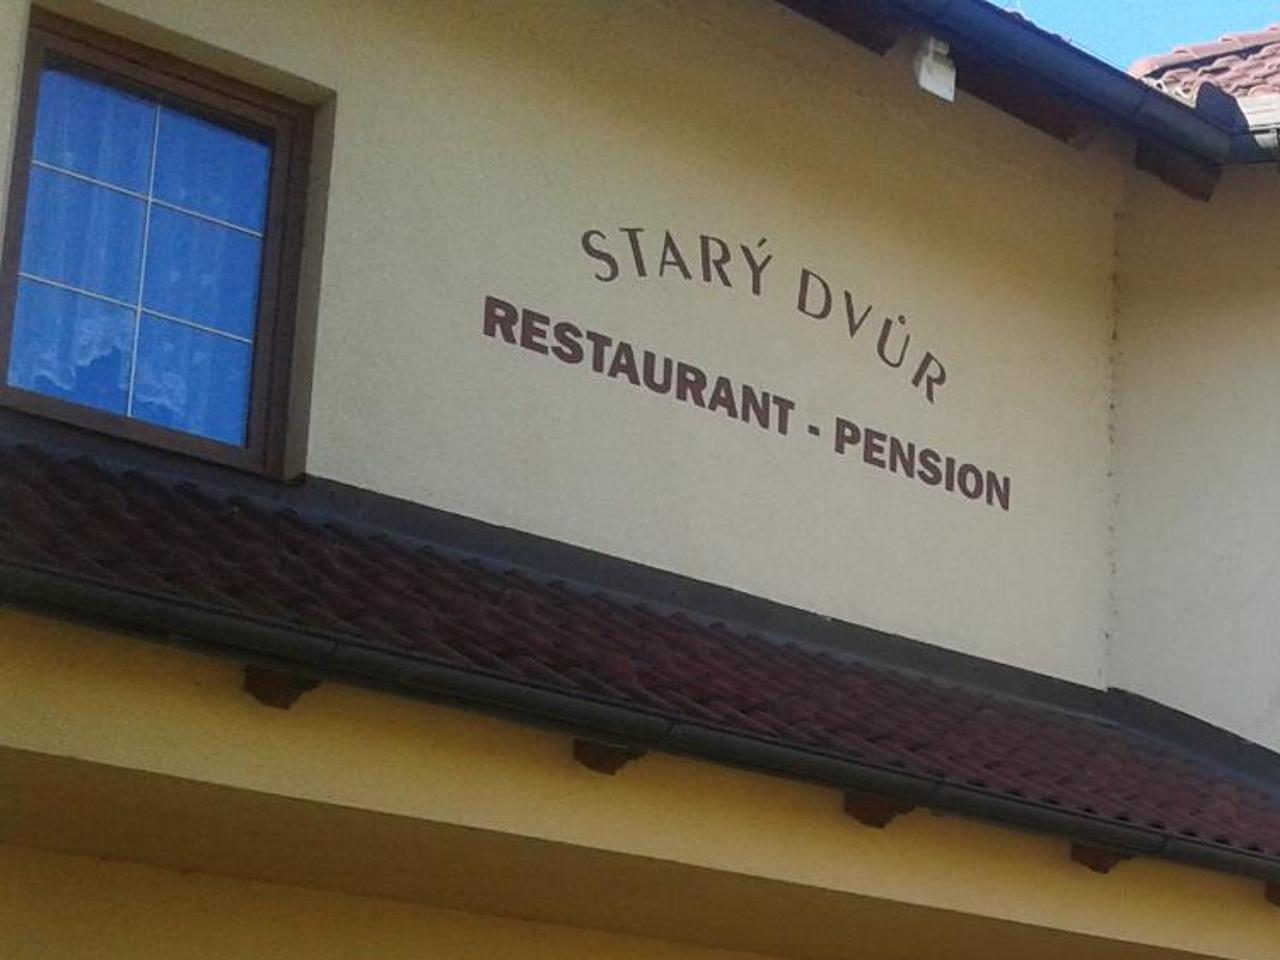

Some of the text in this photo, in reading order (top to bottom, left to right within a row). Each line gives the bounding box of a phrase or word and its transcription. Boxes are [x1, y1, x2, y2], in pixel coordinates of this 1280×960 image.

[483, 295, 795, 436] RESTAURANT
[834, 417, 1011, 511] PENSION
[581, 227, 947, 403] STARÝ DVŮR
